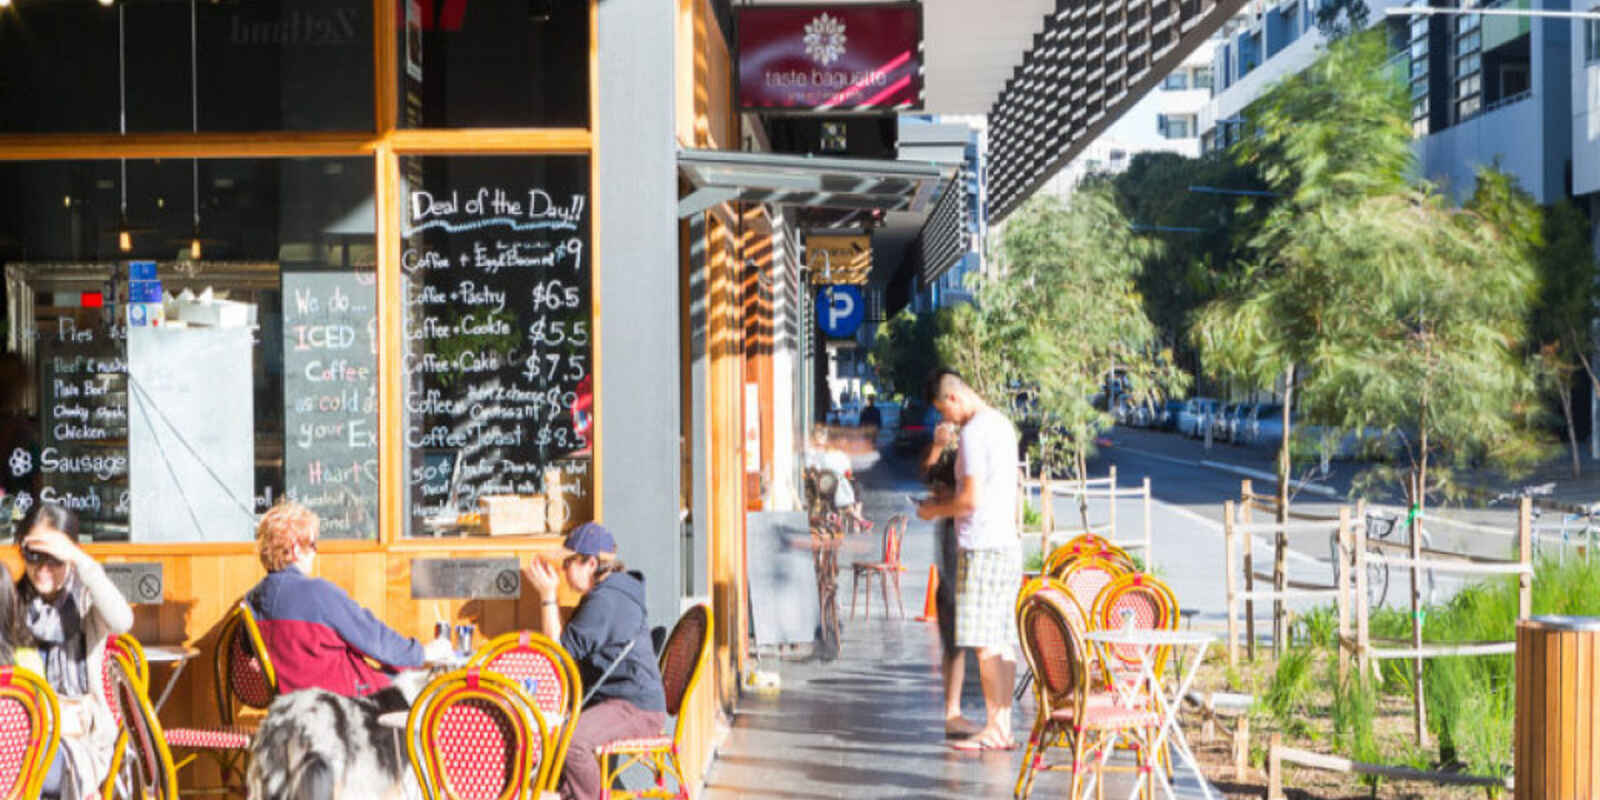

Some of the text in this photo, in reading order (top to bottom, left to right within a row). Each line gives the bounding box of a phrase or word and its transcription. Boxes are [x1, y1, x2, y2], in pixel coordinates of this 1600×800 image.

[765, 69, 887, 90] taste baguette
[412, 187, 585, 222] Deal of the Day!!
[402, 249, 450, 274] Coffee
[296, 286, 320, 315] We
[403, 282, 447, 305] Coffee
[459, 280, 506, 314] Pastry
[532, 280, 580, 312] $6.5
[828, 291, 854, 329] P
[293, 325, 355, 351] ICED
[402, 315, 450, 340] Coffee
[460, 314, 512, 336] Cookie
[528, 313, 588, 346] $5.5
[305, 359, 369, 382] Coffee
[402, 351, 450, 375] Coffee
[521, 347, 586, 382] $7.5
[320, 389, 361, 412] cold
[54, 423, 106, 441] Chicken
[298, 420, 345, 449] your
[406, 425, 467, 448] Coffee
[40, 448, 127, 480] Sausage
